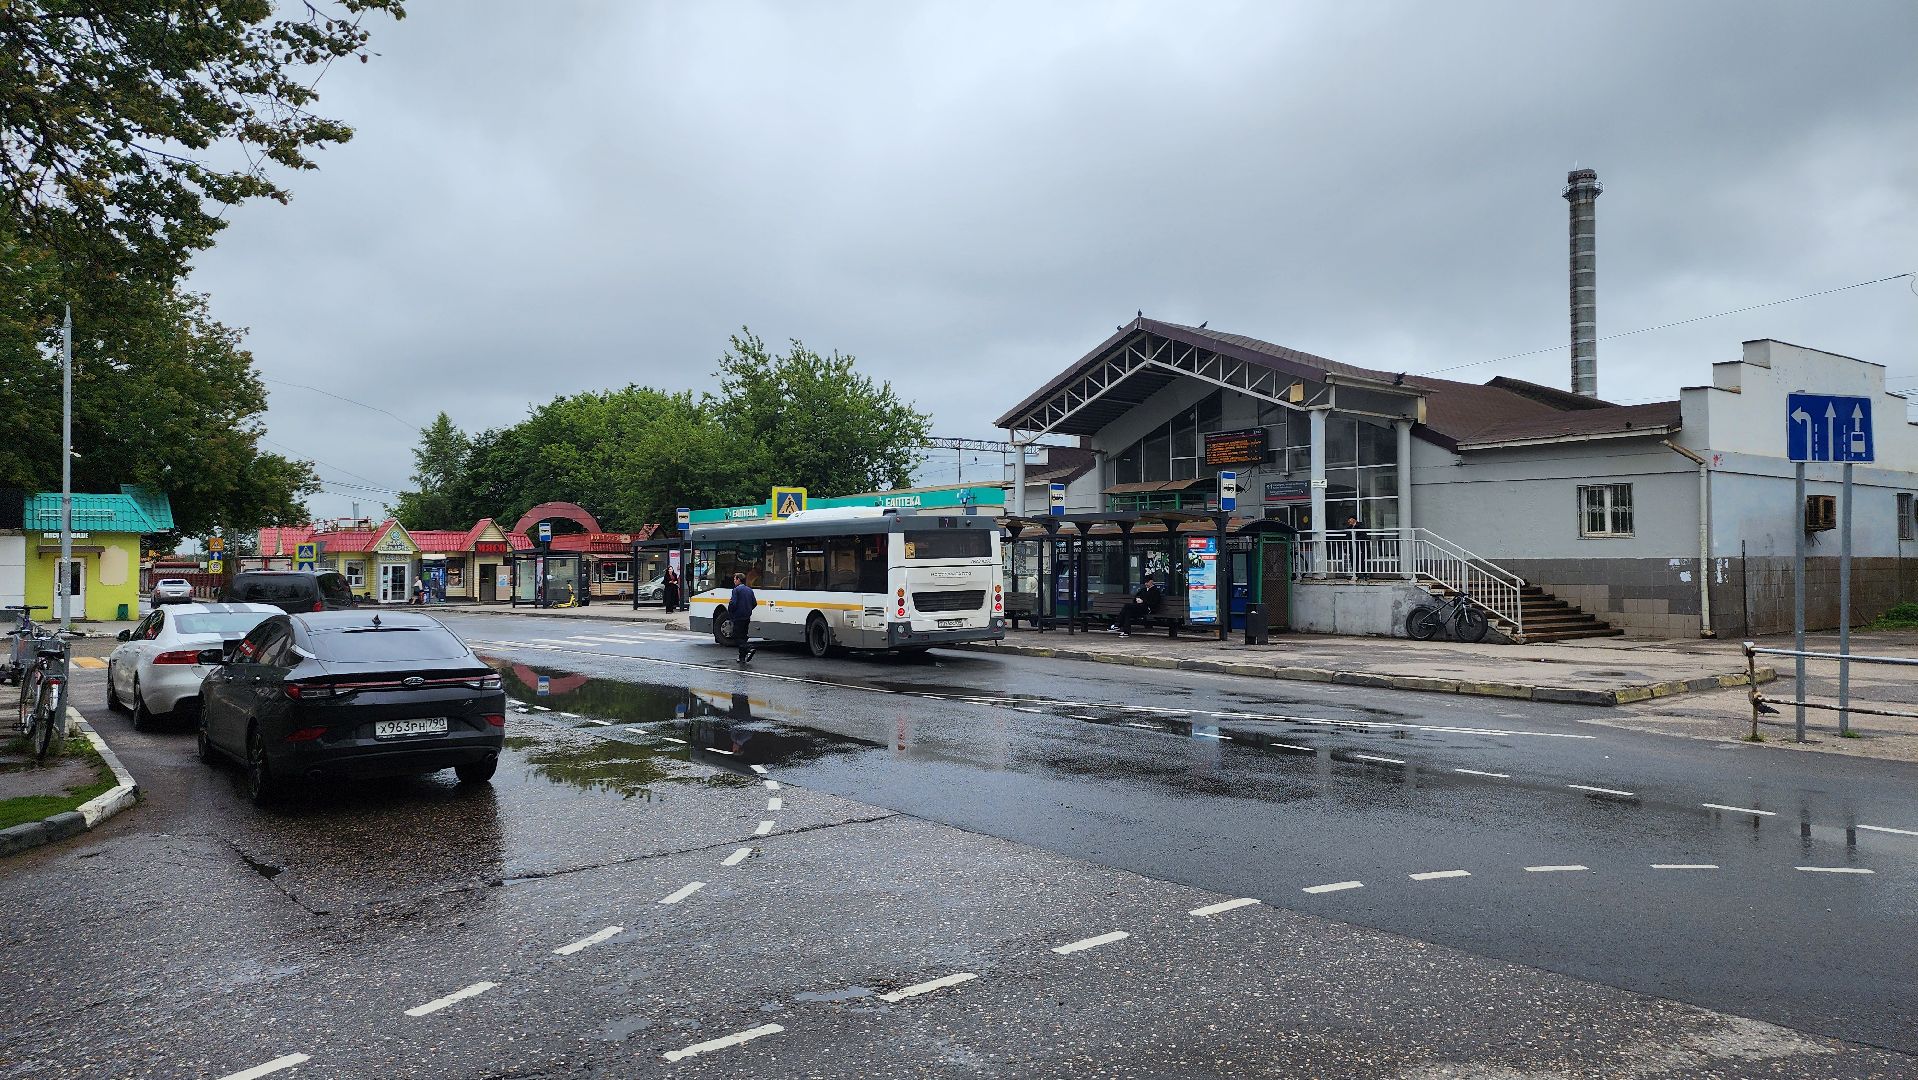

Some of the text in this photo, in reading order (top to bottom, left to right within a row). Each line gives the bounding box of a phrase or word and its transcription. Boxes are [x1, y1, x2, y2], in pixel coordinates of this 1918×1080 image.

[885, 496, 922, 507] ЕАПТЕКА
[477, 543, 506, 553] МЯСО
[427, 717, 446, 729] 790
